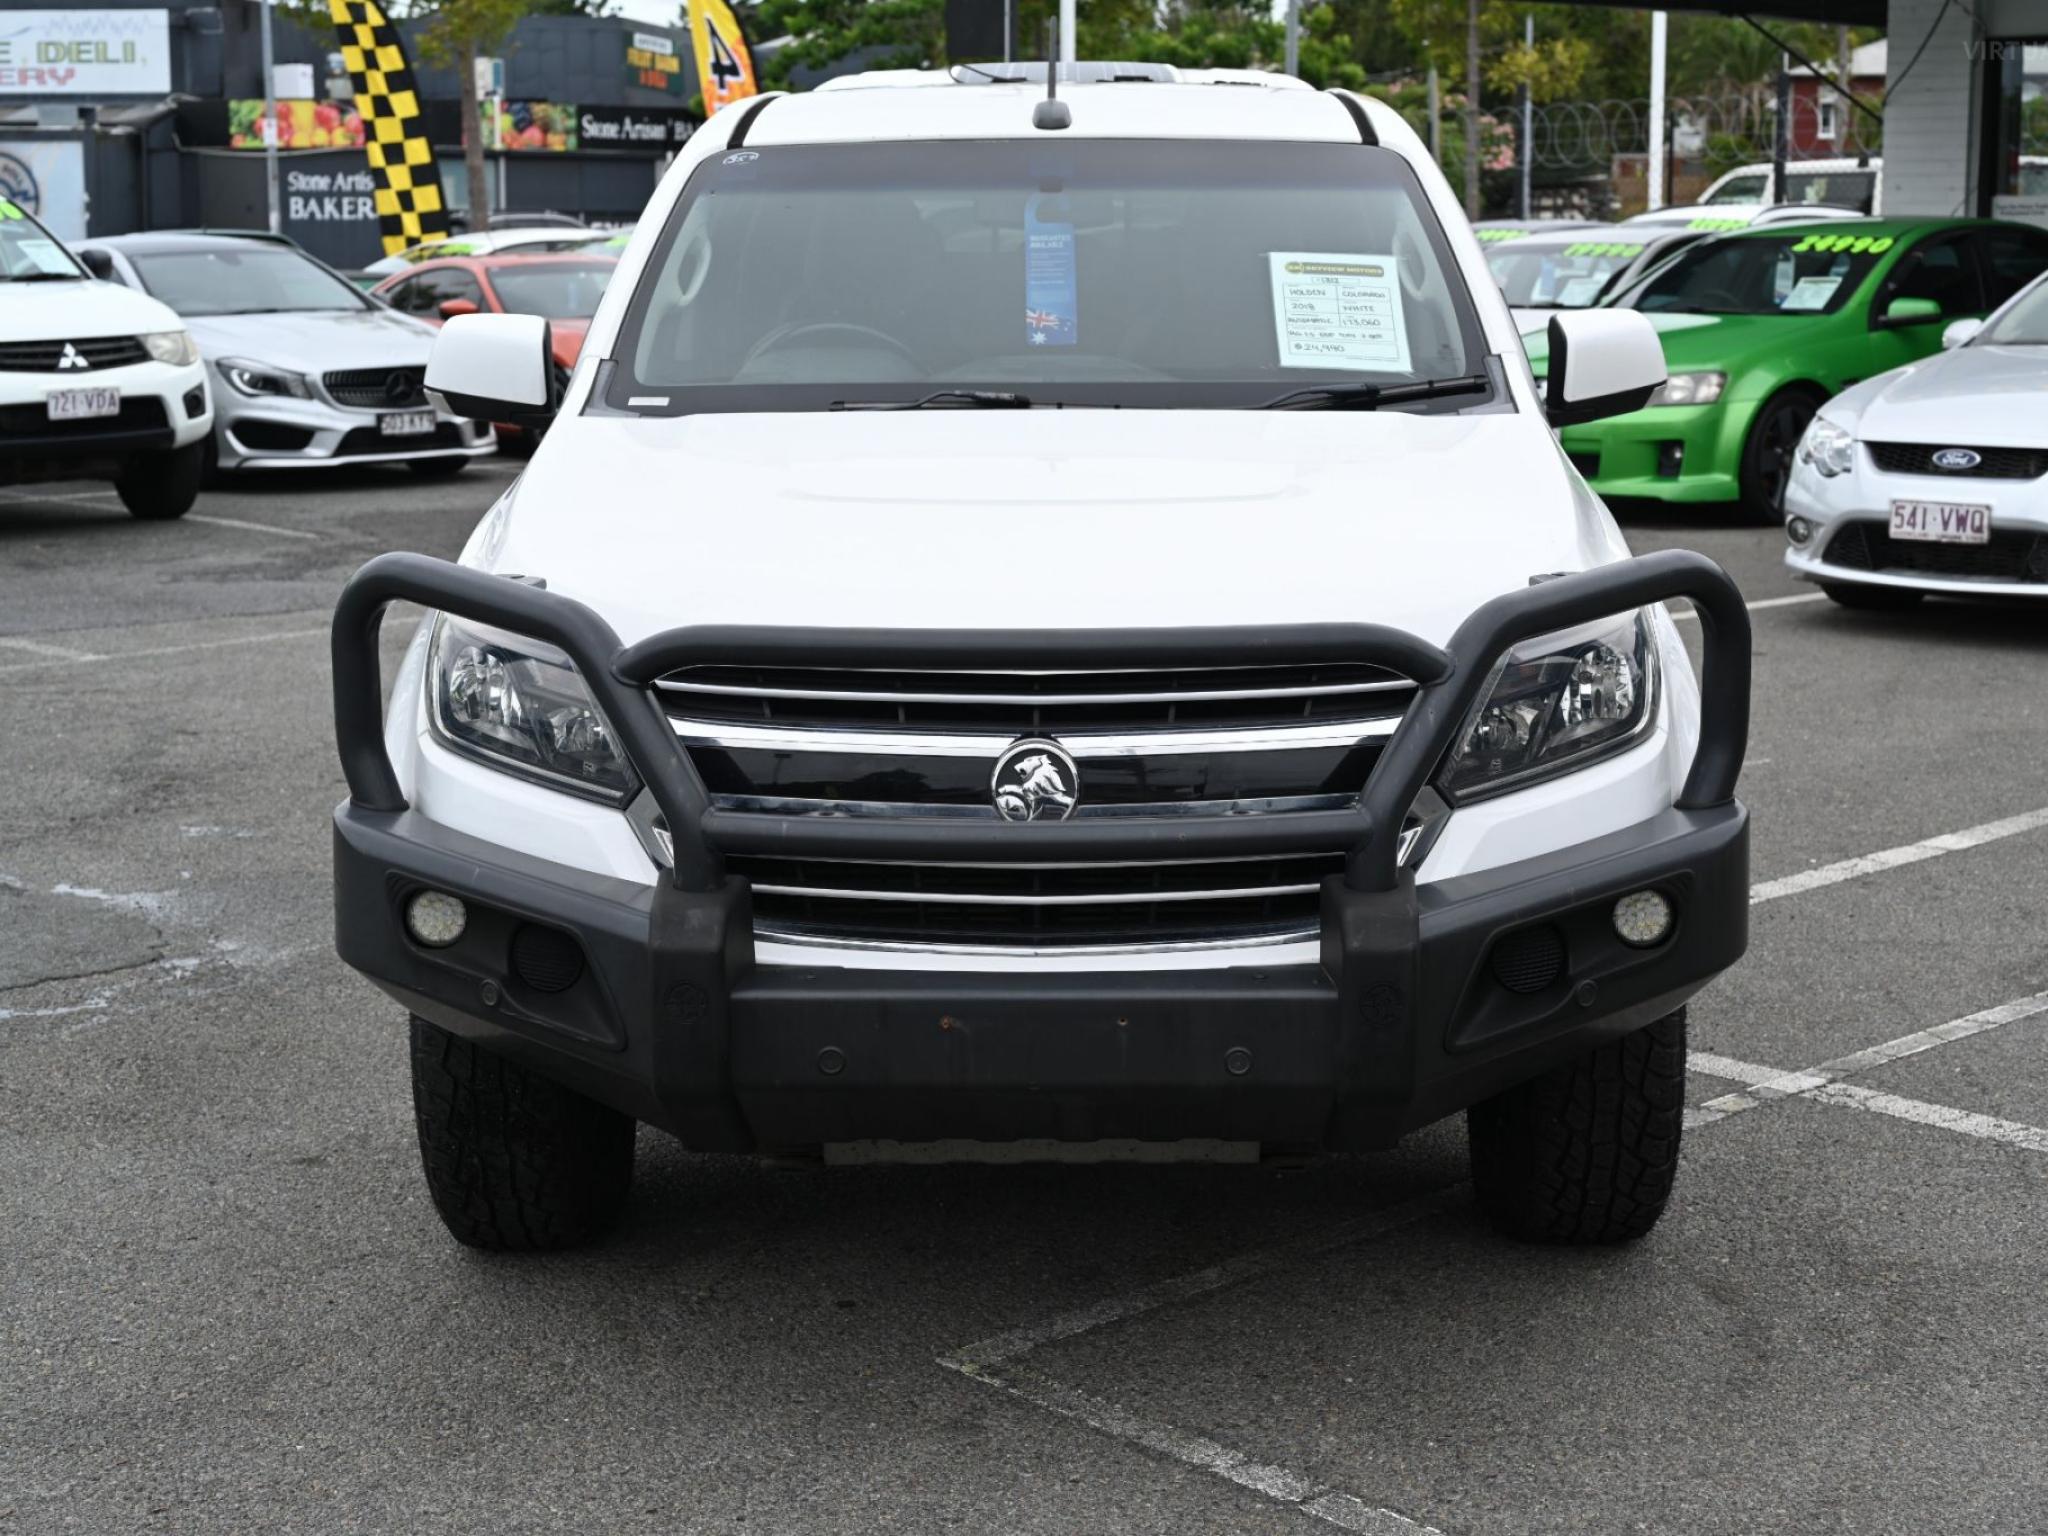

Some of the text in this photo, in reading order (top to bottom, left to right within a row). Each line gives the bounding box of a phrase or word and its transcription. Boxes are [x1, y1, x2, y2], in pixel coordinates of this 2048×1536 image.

[704, 13, 745, 95] 4
[287, 170, 331, 192] Stone
[1893, 504, 1985, 535] 541 VWQ
